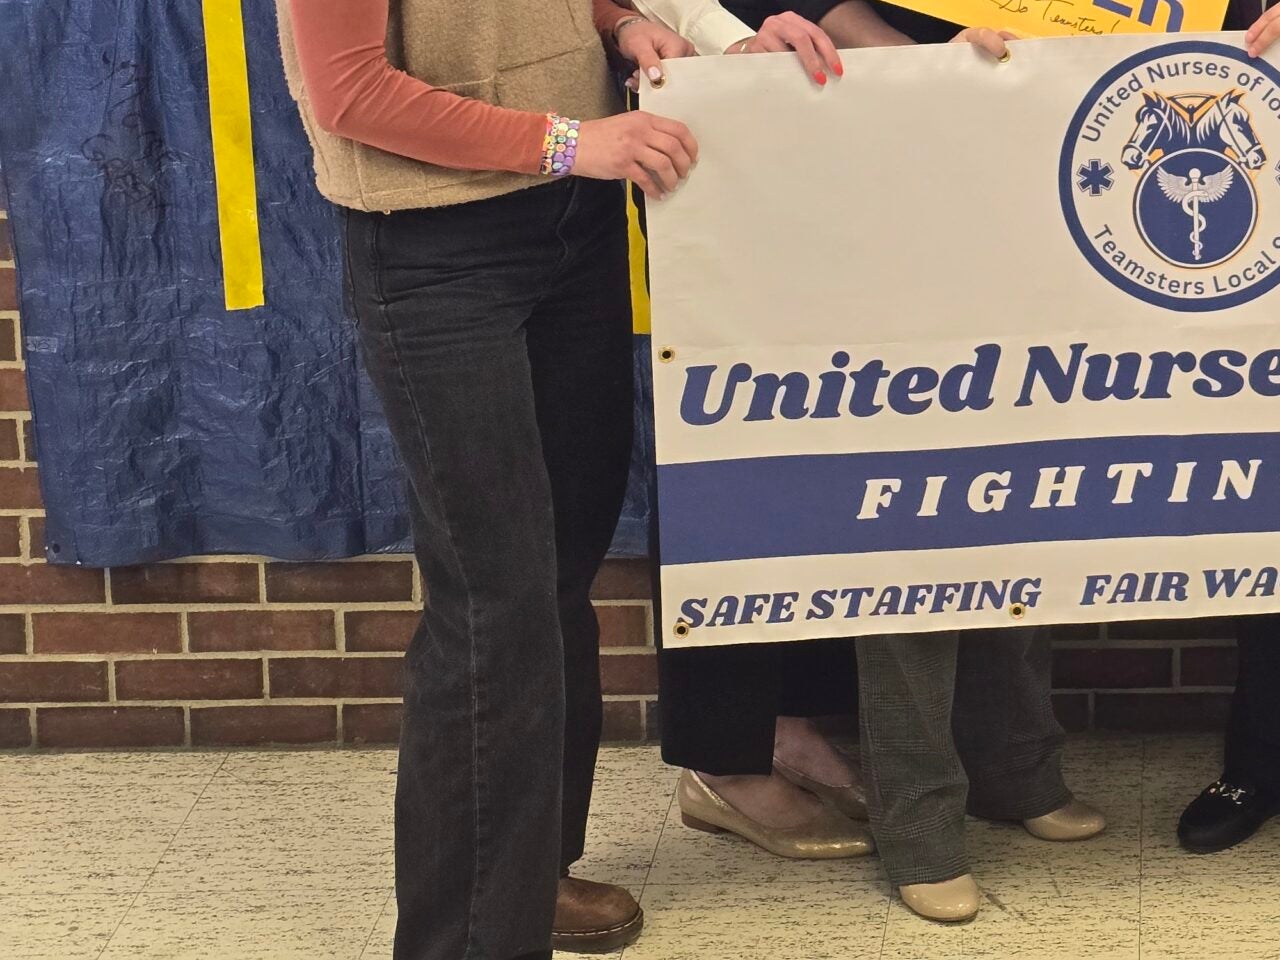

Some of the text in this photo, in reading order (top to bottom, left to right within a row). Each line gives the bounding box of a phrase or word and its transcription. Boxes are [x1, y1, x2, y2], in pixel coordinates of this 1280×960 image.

[1081, 73, 1144, 143] United
[1146, 60, 1231, 84] Nurses
[1236, 72, 1265, 93] of
[1094, 223, 1205, 295] Teamsters
[1212, 250, 1277, 294] Local
[679, 342, 1002, 426] United
[676, 590, 800, 629] SAFE
[804, 576, 1043, 622] STAFFING
[1079, 571, 1191, 606] FAIR
